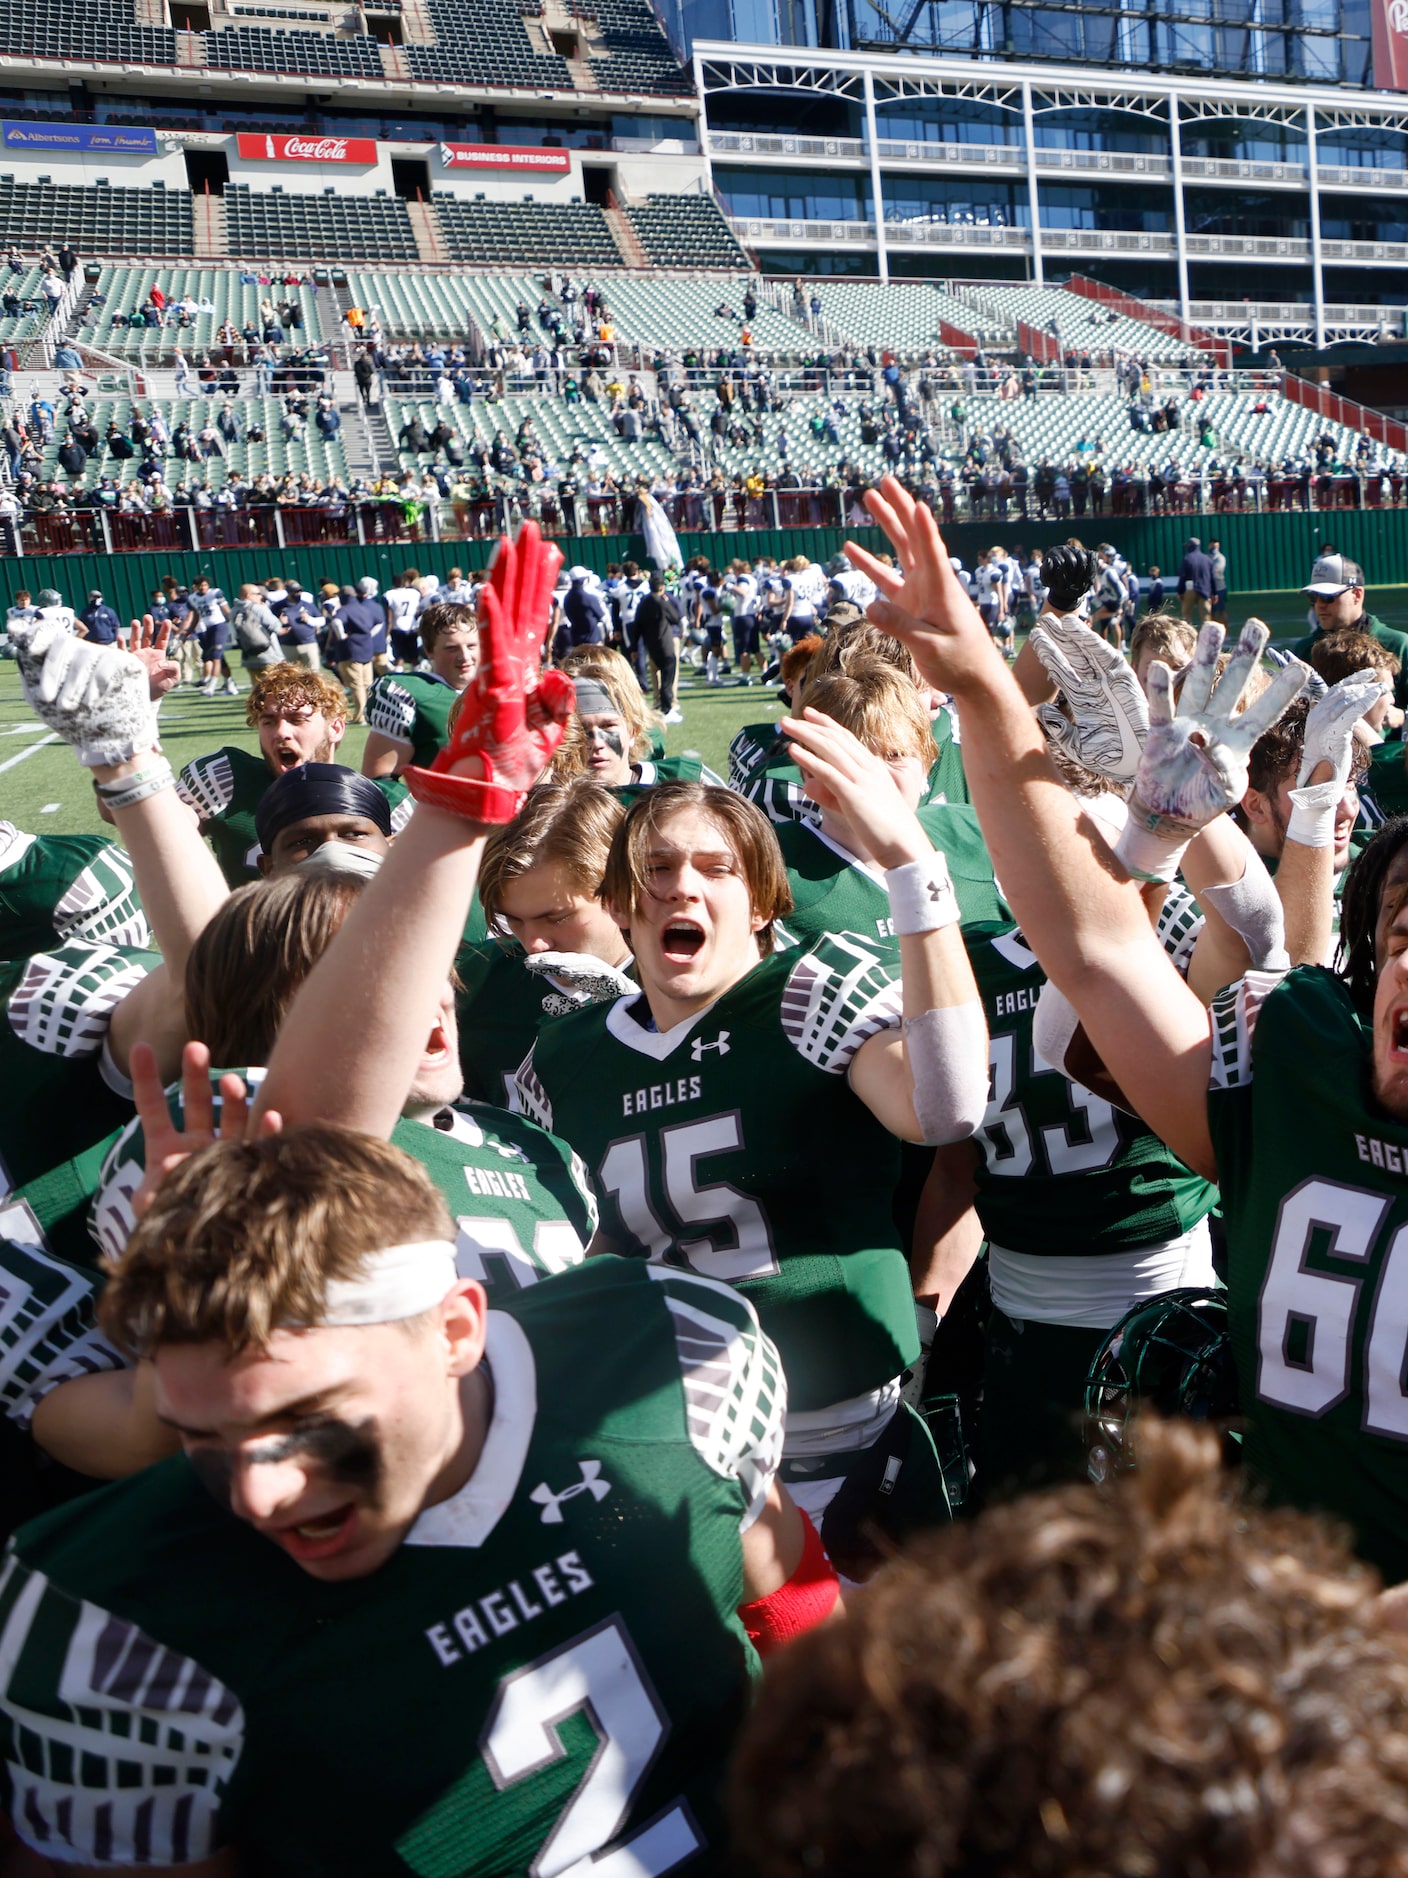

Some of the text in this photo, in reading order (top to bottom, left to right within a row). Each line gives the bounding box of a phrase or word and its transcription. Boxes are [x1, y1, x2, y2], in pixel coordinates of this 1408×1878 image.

[28, 132, 153, 146] Albertsons Tom Thumb
[284, 137, 349, 159] Coca-Cola
[456, 151, 566, 165] BUSINESS INTERIORS
[401, 601, 410, 617] 7
[995, 984, 1046, 1017] EAGL
[622, 1075, 702, 1118] EAGLES
[463, 1164, 532, 1202] EAGLES
[597, 1108, 782, 1283] 15
[425, 1549, 595, 1668] EAGLES
[477, 1610, 710, 1878] 2
